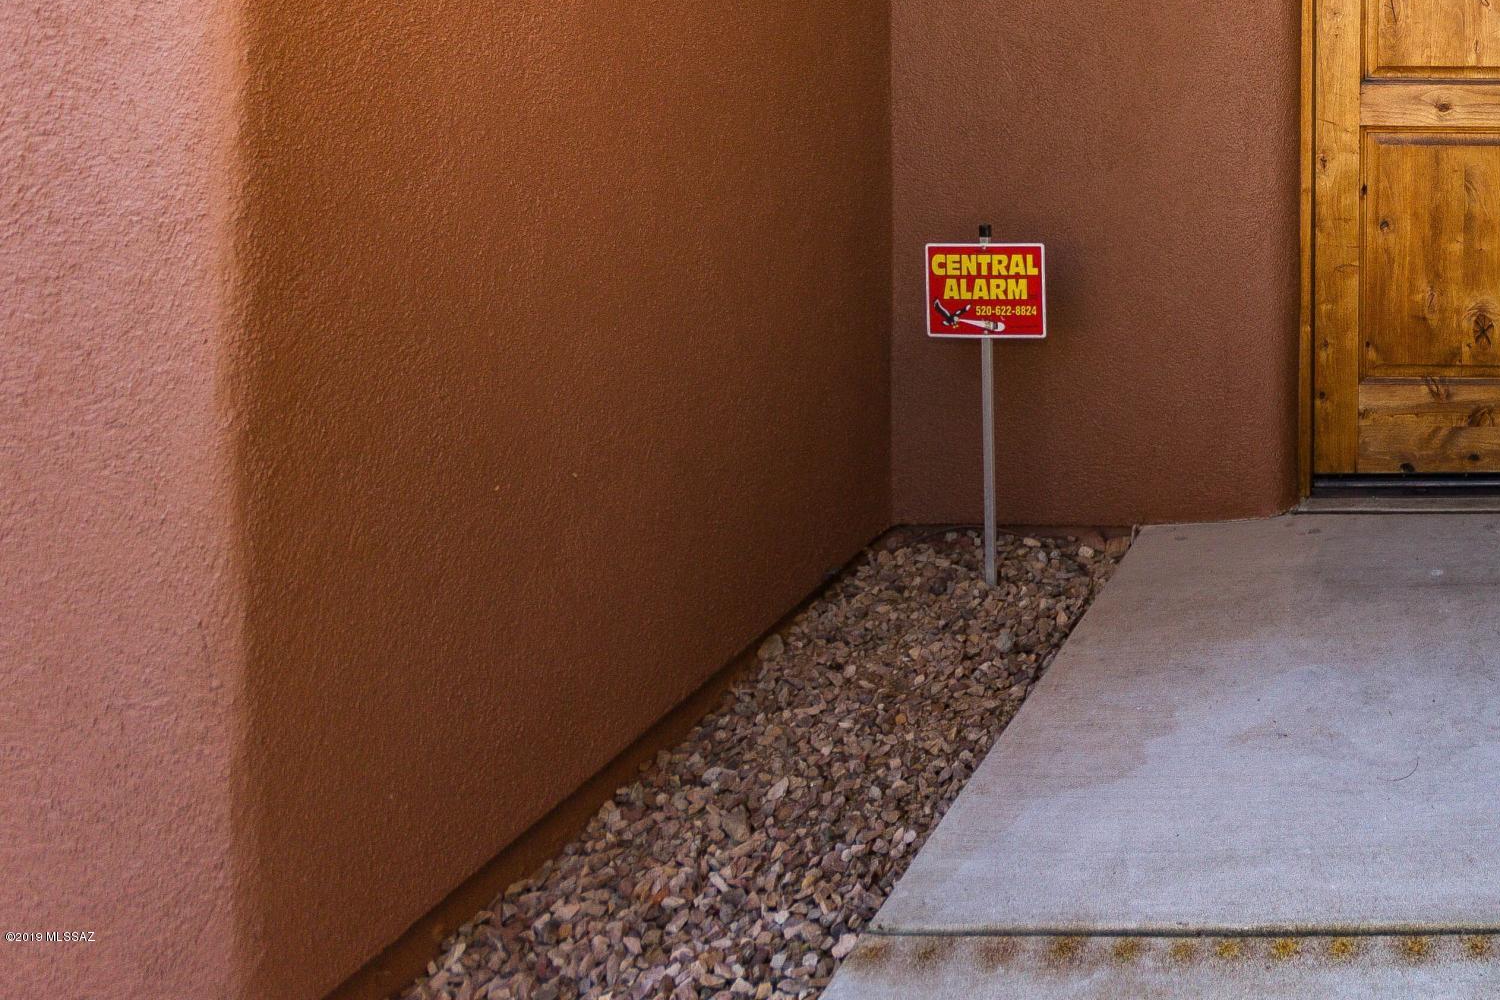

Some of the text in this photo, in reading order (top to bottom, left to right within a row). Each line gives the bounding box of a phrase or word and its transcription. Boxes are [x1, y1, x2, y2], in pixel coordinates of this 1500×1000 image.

[931, 254, 1039, 275] CENTRAL
[943, 278, 1028, 300] ALARM
[975, 305, 1037, 316] 520-622-8824
